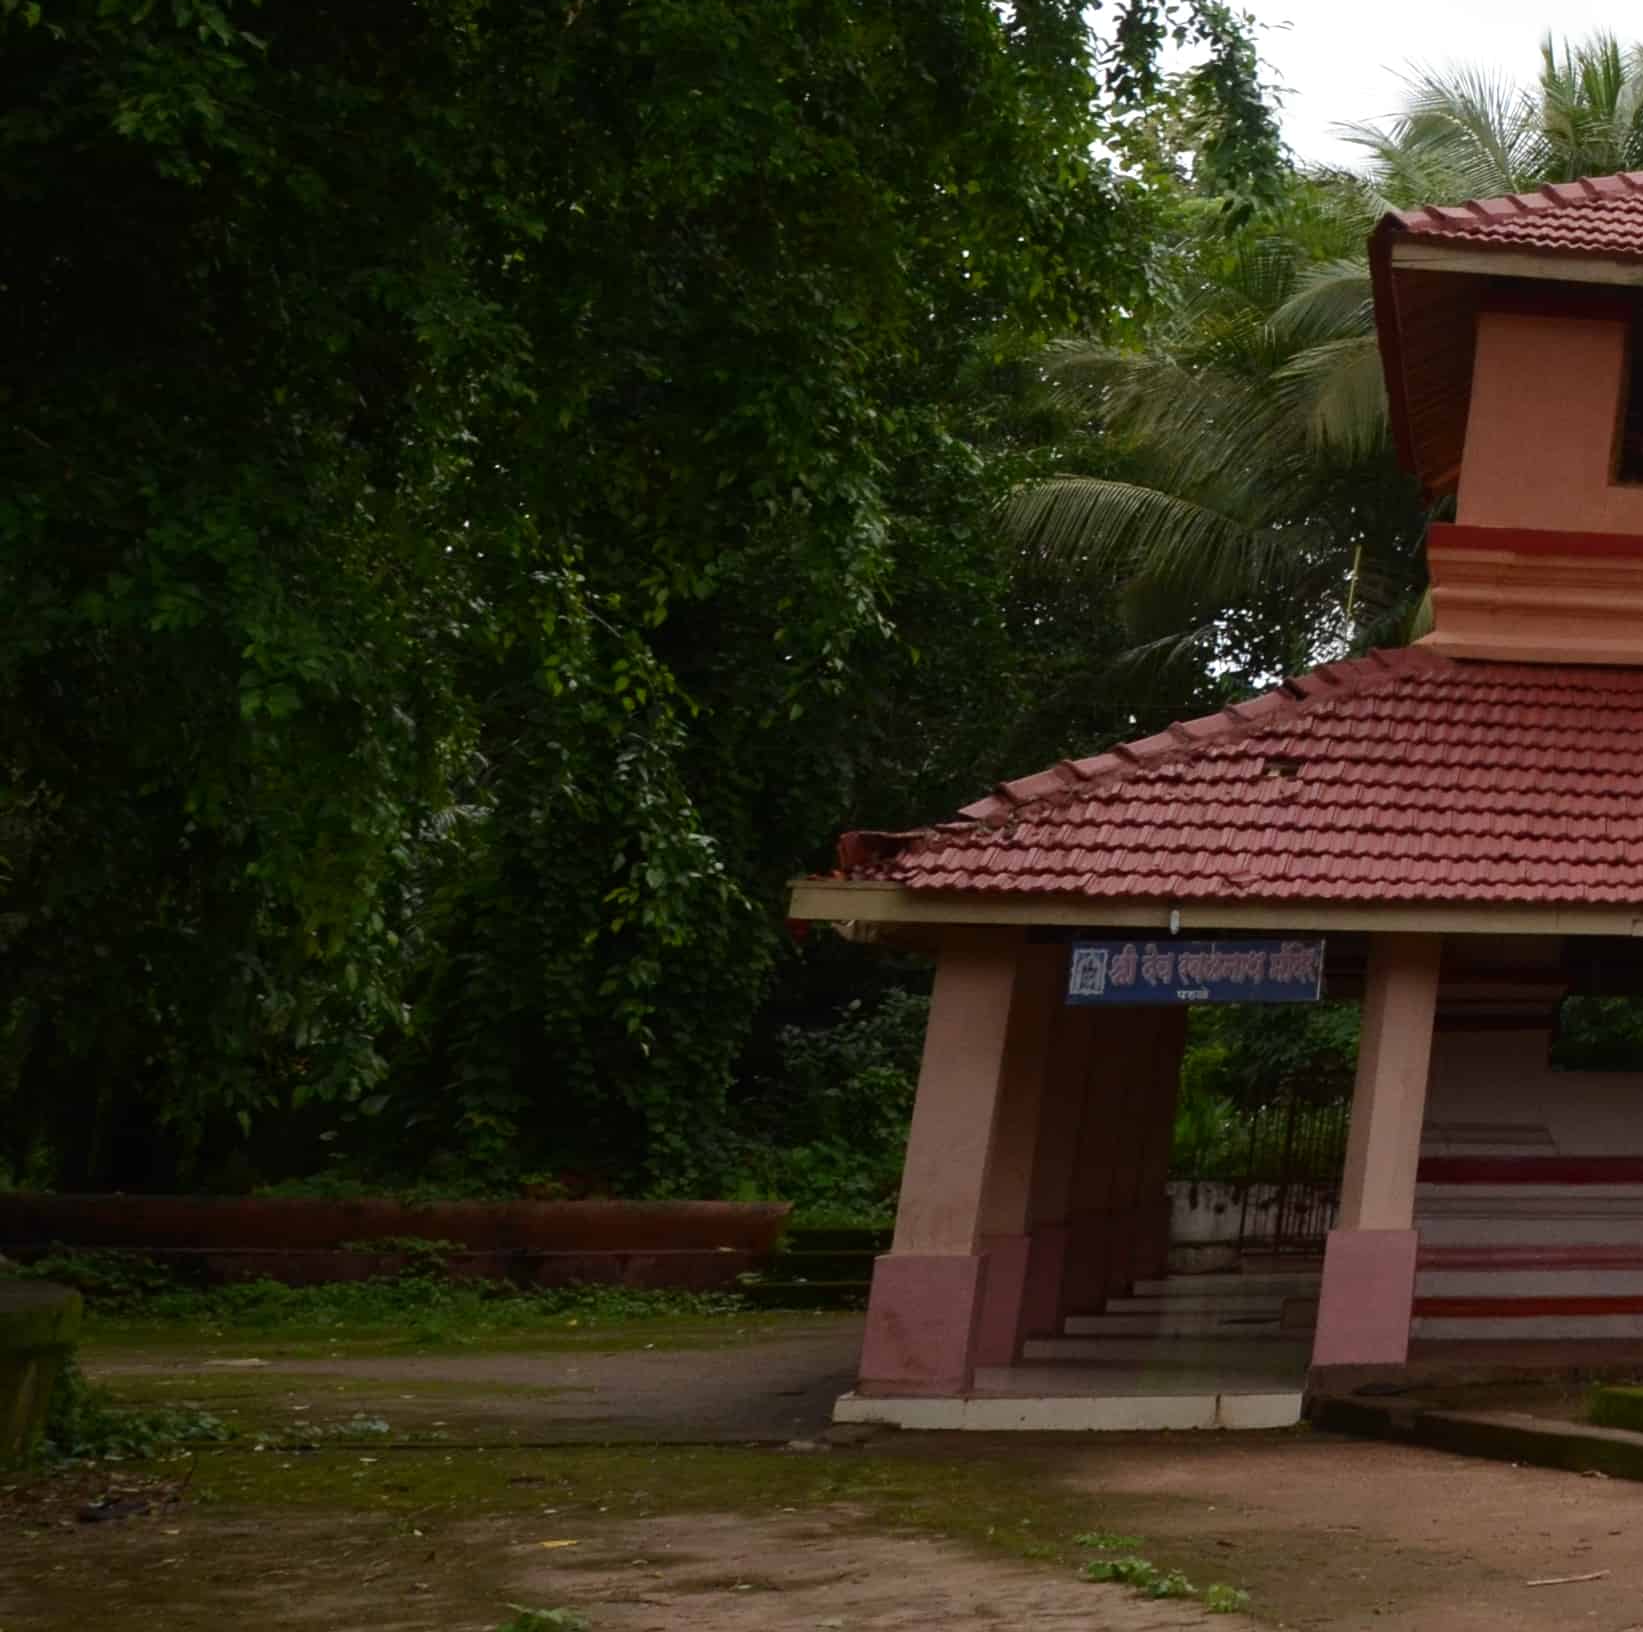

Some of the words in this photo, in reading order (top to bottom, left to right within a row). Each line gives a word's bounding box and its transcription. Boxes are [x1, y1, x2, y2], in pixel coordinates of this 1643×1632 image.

[1110, 943, 1137, 985] श्री
[1142, 943, 1173, 986] देव
[1269, 941, 1317, 984] मंदिर
